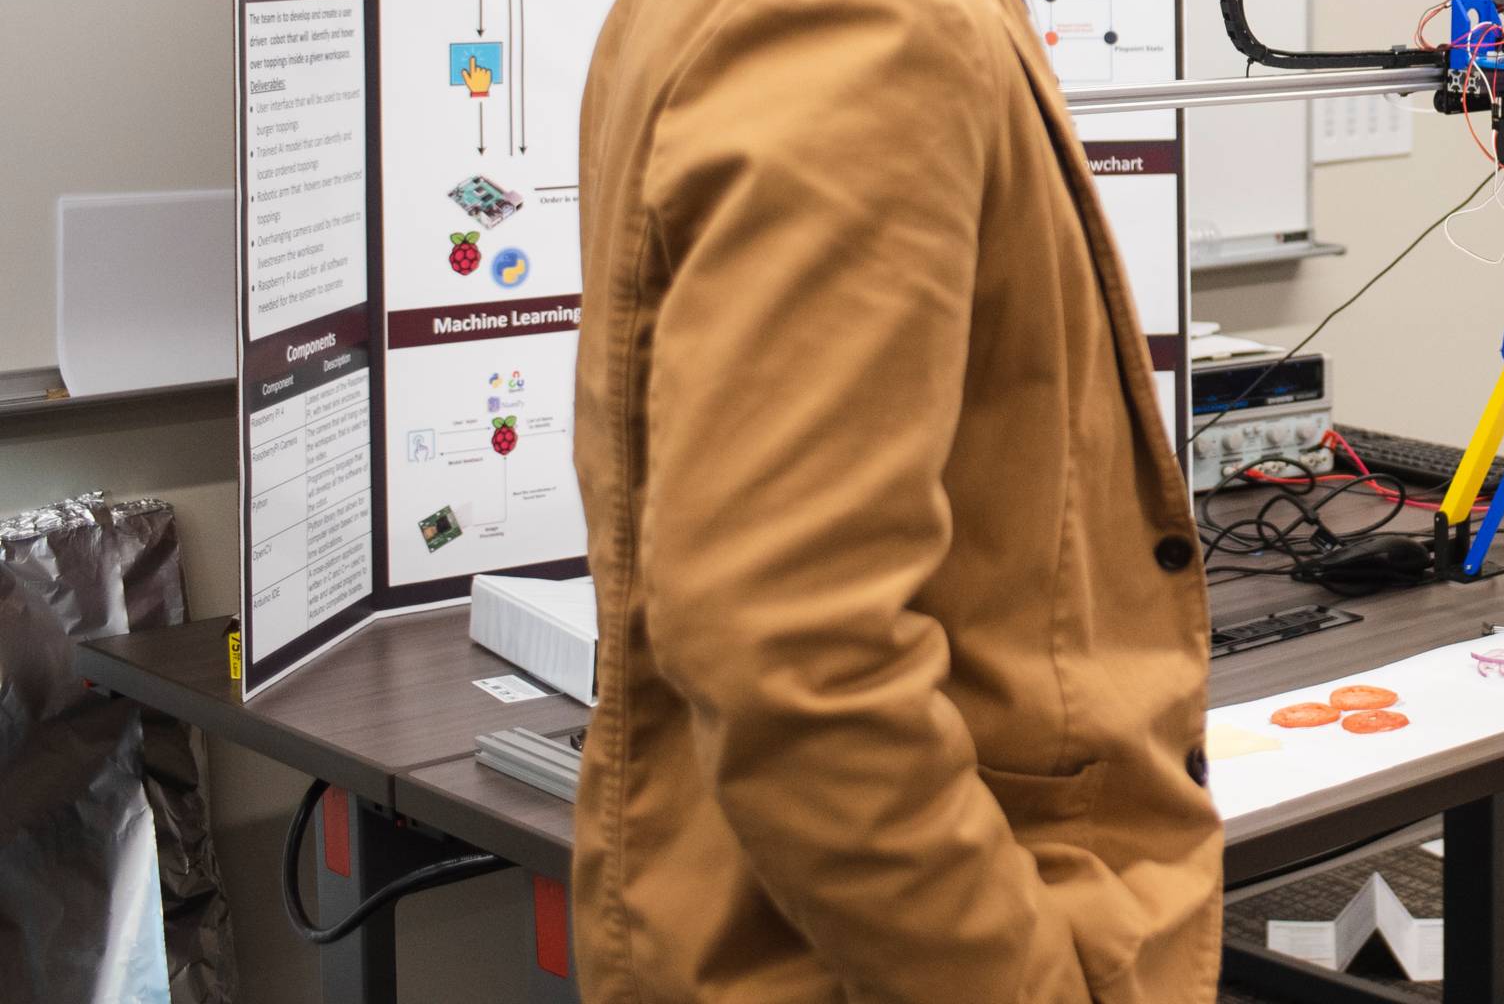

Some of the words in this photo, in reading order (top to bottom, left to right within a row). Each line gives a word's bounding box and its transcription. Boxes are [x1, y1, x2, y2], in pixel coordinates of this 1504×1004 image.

[1088, 155, 1143, 172] wchart
[433, 313, 508, 335] Machine
[511, 305, 581, 327] Learning
[286, 332, 336, 362] Components
[262, 374, 294, 396] Component
[323, 353, 351, 373] Description
